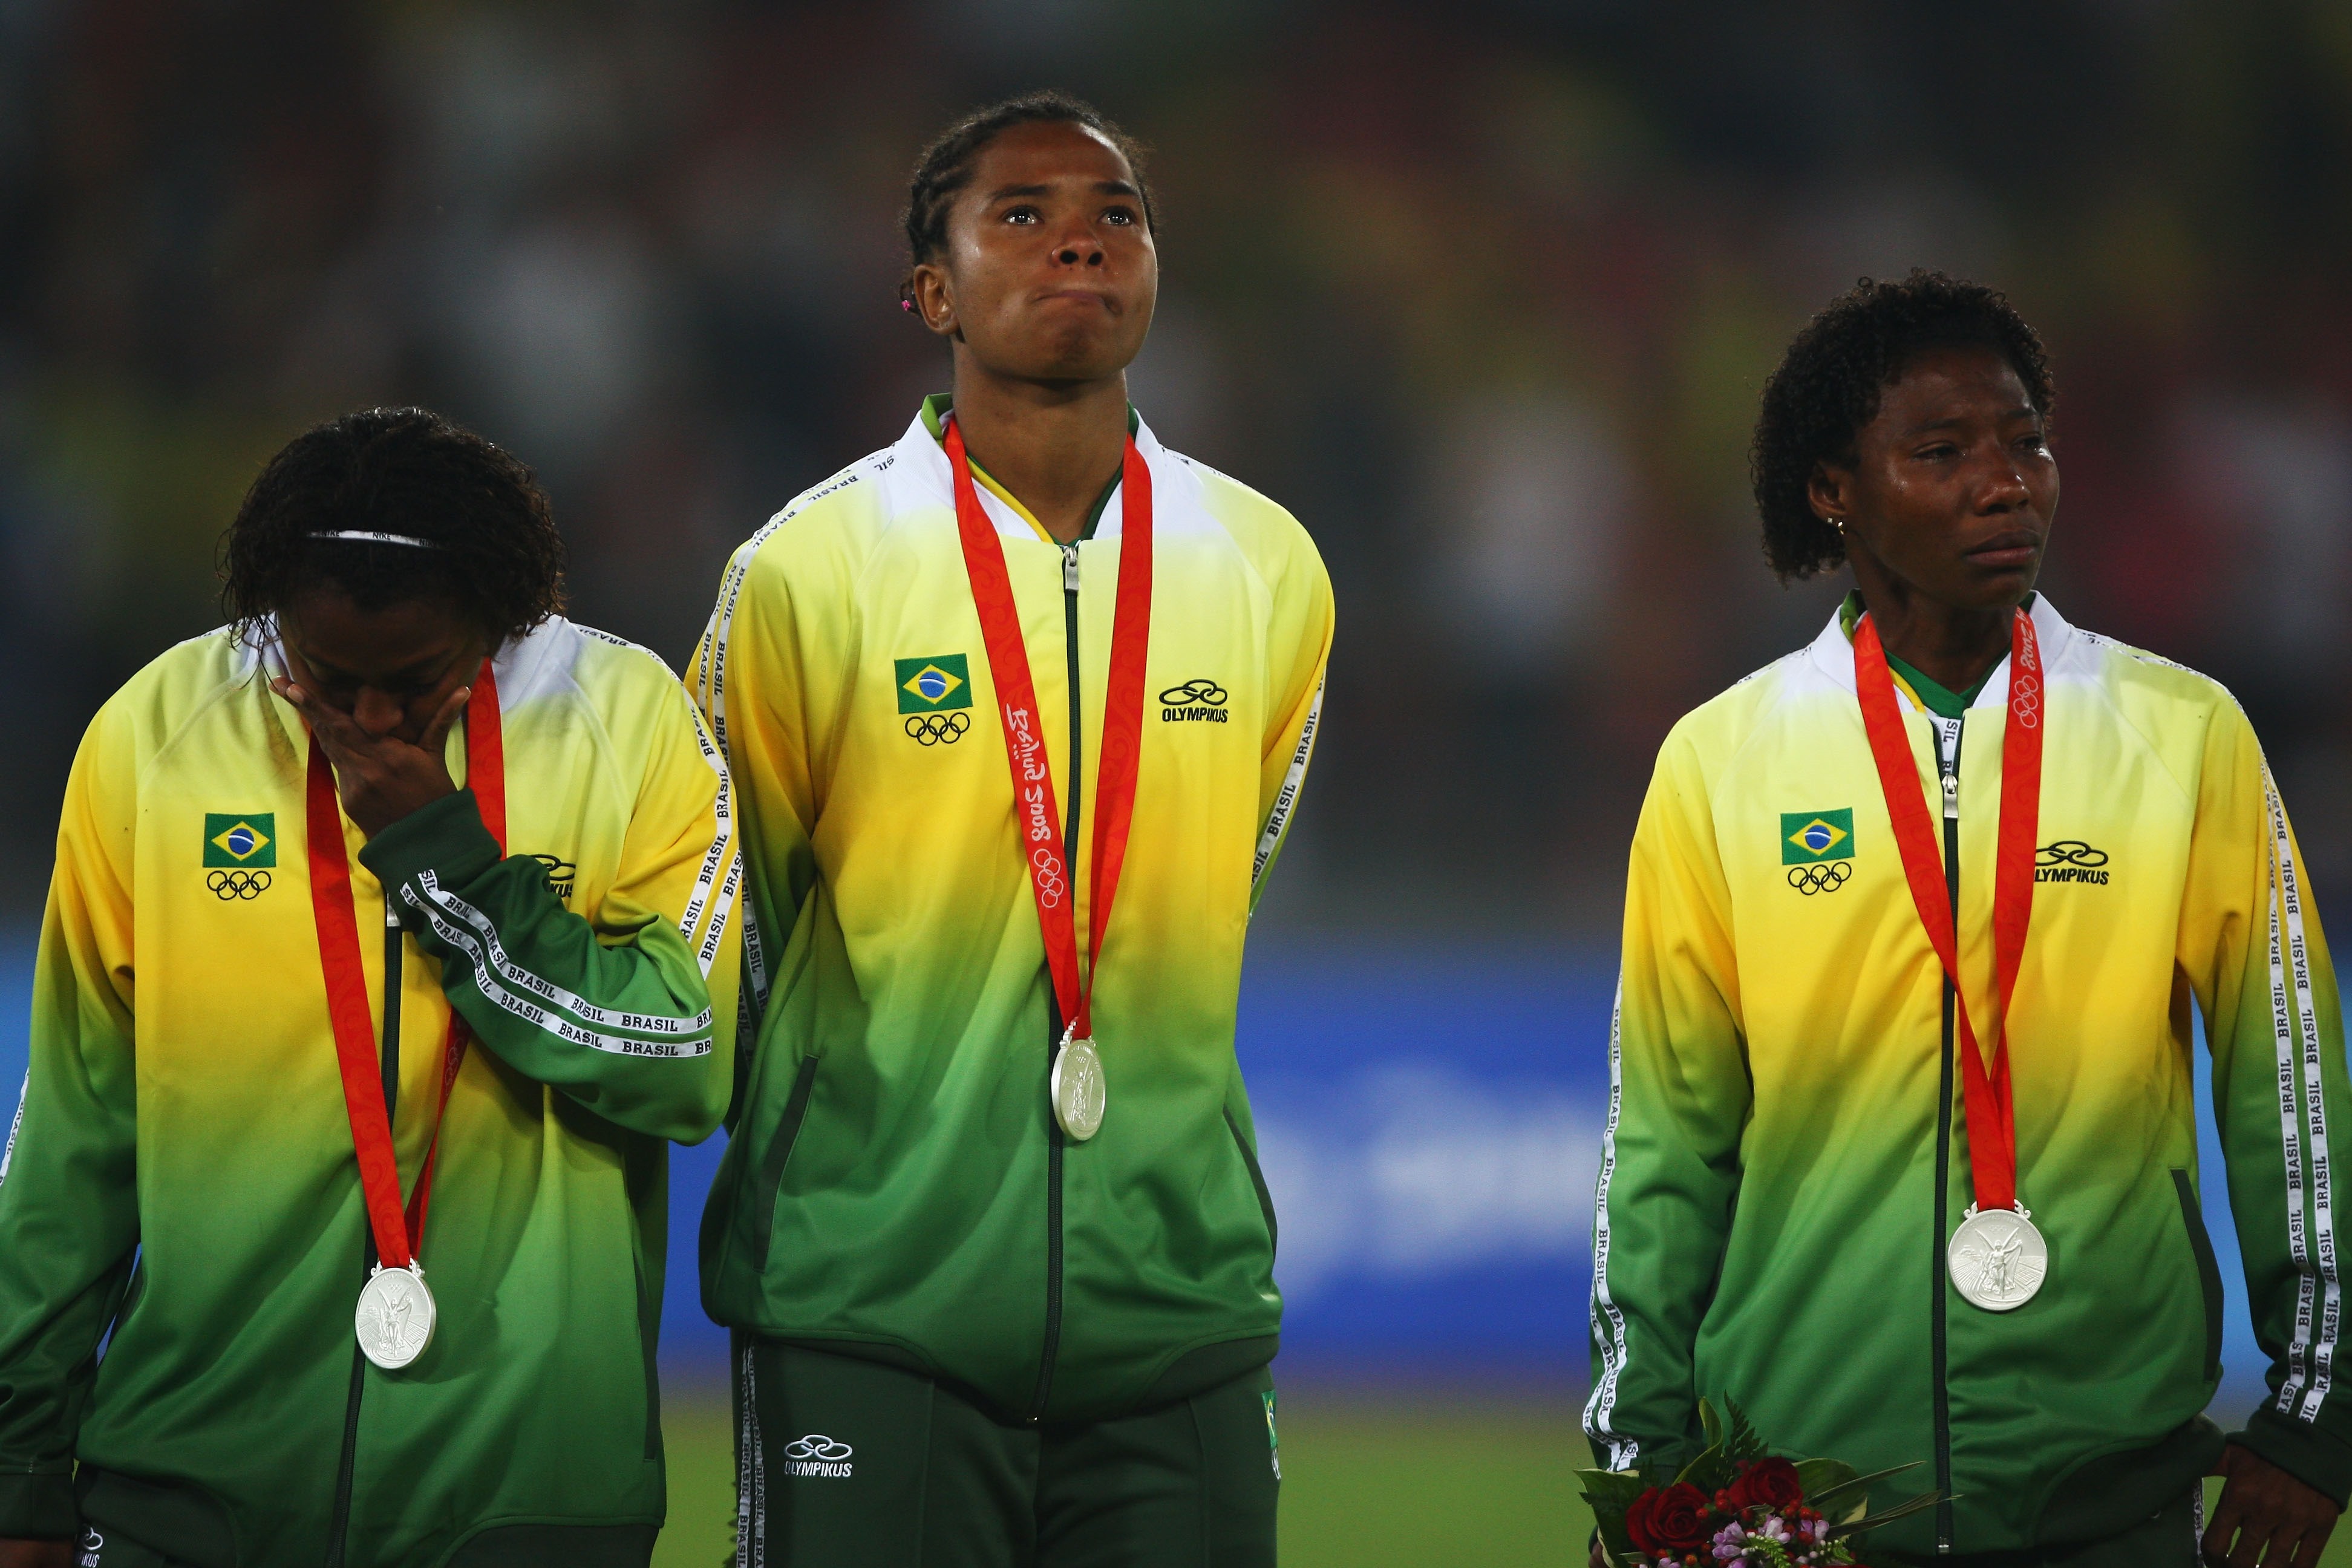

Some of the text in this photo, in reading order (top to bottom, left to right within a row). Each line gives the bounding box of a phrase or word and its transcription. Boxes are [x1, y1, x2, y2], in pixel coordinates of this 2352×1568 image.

[808, 475, 859, 501] BRASIL
[874, 455, 895, 471] SIL
[373, 532, 391, 540] NIKE
[753, 510, 797, 548] BRASIL
[723, 566, 746, 621] BRASIL
[699, 632, 712, 687] BRASIL
[714, 640, 726, 696] BRASIL
[1162, 707, 1229, 723] OLYMPIKUS
[1942, 720, 1959, 743] SIL
[580, 629, 730, 939] RASIL BRASIL BRASIL BRASIL BRASIL
[1266, 784, 1297, 838] BRASIL
[1293, 711, 1318, 766] BRASIL
[1025, 784, 1051, 841] 2008
[2034, 868, 2109, 886] LYMPIKUS
[2282, 860, 2299, 915] BRASIL
[420, 870, 436, 893] SIL
[483, 924, 507, 970] BRASI
[508, 965, 555, 999] BRASIL
[570, 998, 604, 1022] BRASIL
[621, 1014, 678, 1031] BRASIL
[700, 913, 725, 961] BRASIL
[743, 923, 762, 973] BRASIL
[2271, 910, 2281, 965] BRASIL
[2292, 935, 2308, 990] BRASIL
[403, 889, 420, 907] SIL
[468, 943, 492, 993] BRASIL
[500, 993, 544, 1024] BRASIL
[558, 1022, 603, 1048] BRASIL
[622, 1040, 679, 1056] BRASIL
[1612, 1008, 1620, 1063] BRASIL
[2273, 983, 2290, 1038] BRASIL
[2302, 1009, 2318, 1064] BRASIL
[1605, 1083, 1620, 1137] BRASIL
[2280, 1059, 2295, 1114] BRASIL
[2308, 1080, 2324, 1135] BRASIL
[1598, 1158, 1614, 1212] BRASIL
[2286, 1134, 2301, 1190] BRASIL
[2316, 1156, 2328, 1209] BRASIL
[1596, 1229, 1609, 1284] BRASIL
[2291, 1209, 2308, 1264] BRASIL
[2319, 1229, 2337, 1282] BRASIL
[1603, 1302, 1625, 1352] BRASIL
[2299, 1272, 2314, 1327] BRASIL
[2324, 1300, 2339, 1343] RASIL
[2316, 1353, 2331, 1391] RASIL
[742, 1442, 751, 1495] BRASIL
[785, 1461, 853, 1477] OLYMPIKUS
[736, 1514, 748, 1568] BRASIL
[756, 1466, 764, 1568] BRASIL BRA
